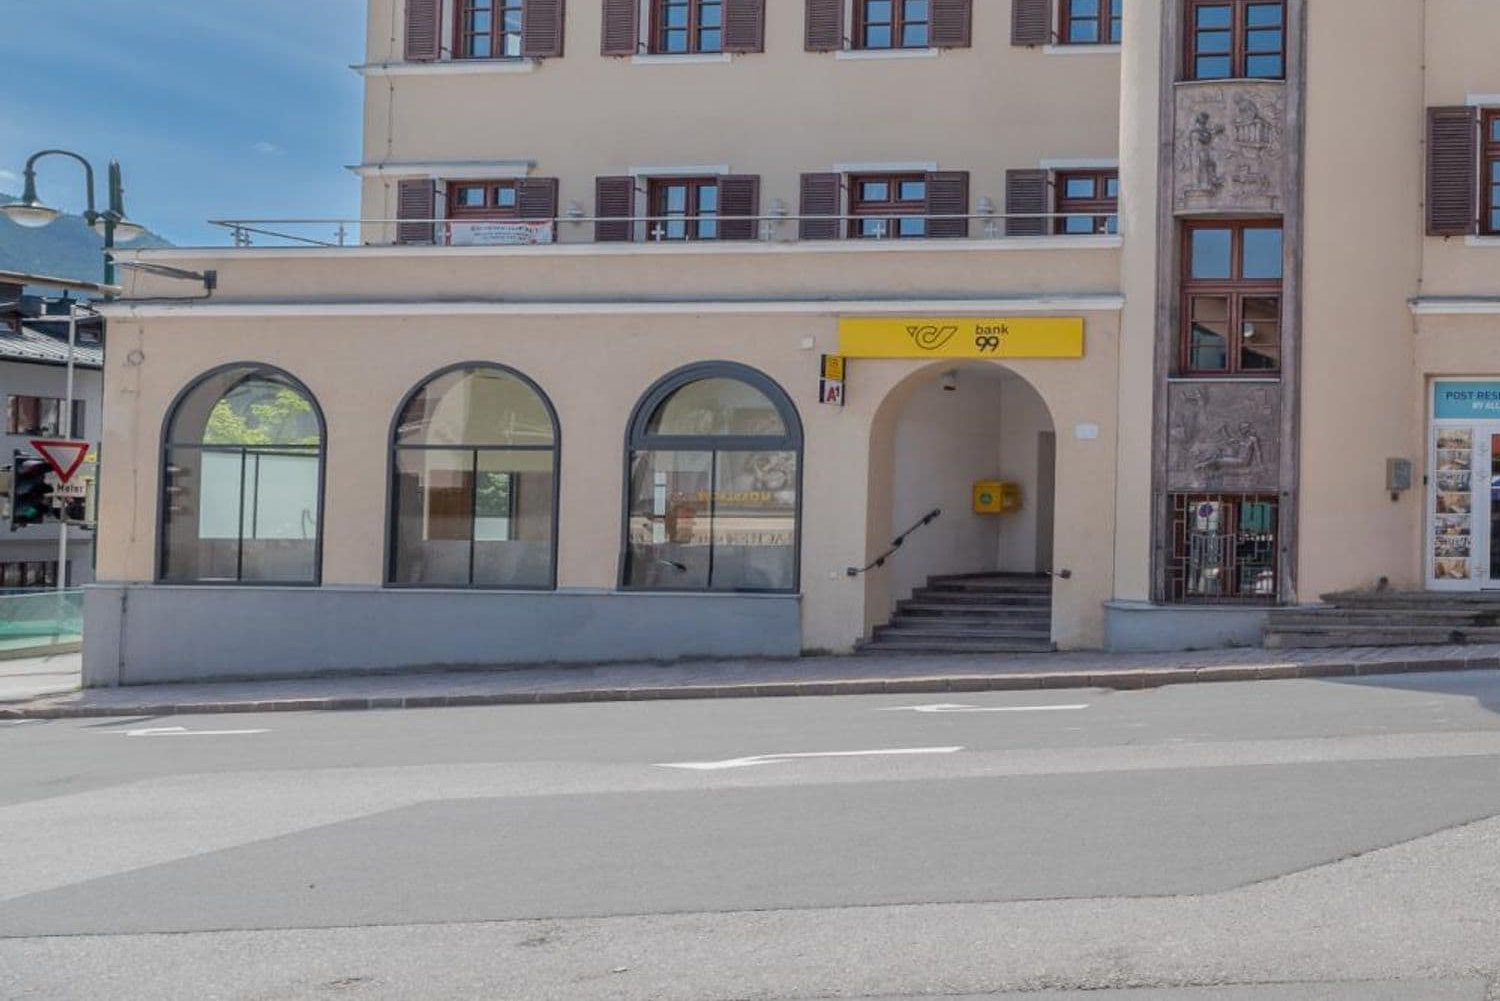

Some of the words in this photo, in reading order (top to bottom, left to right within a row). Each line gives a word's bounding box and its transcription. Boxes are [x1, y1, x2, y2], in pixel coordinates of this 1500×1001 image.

[975, 323, 1009, 335] bank
[975, 336, 999, 352] 99
[826, 385, 840, 402] A1
[1446, 391, 1473, 400] POST
